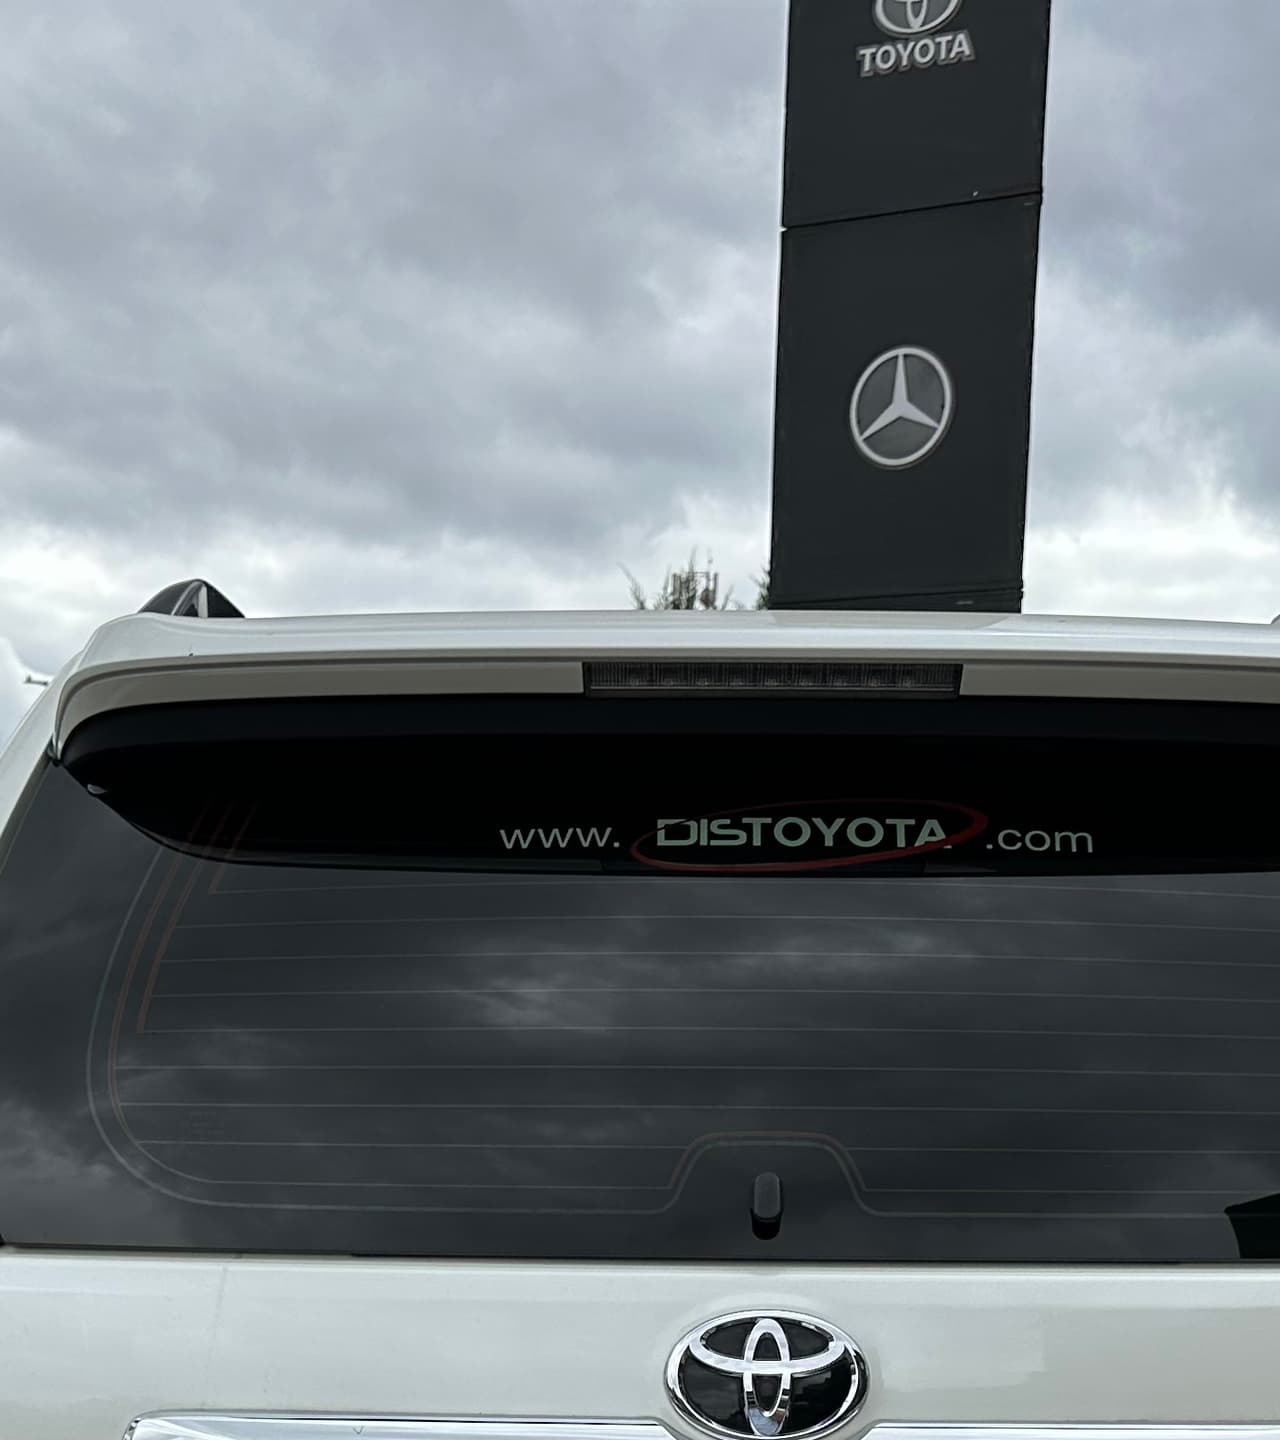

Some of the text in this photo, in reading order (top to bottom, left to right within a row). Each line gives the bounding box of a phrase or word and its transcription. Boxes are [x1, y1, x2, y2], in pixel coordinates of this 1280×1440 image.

[857, 31, 973, 75] TOYOTA
[499, 815, 1094, 853] www. DISTOYOTA .com
